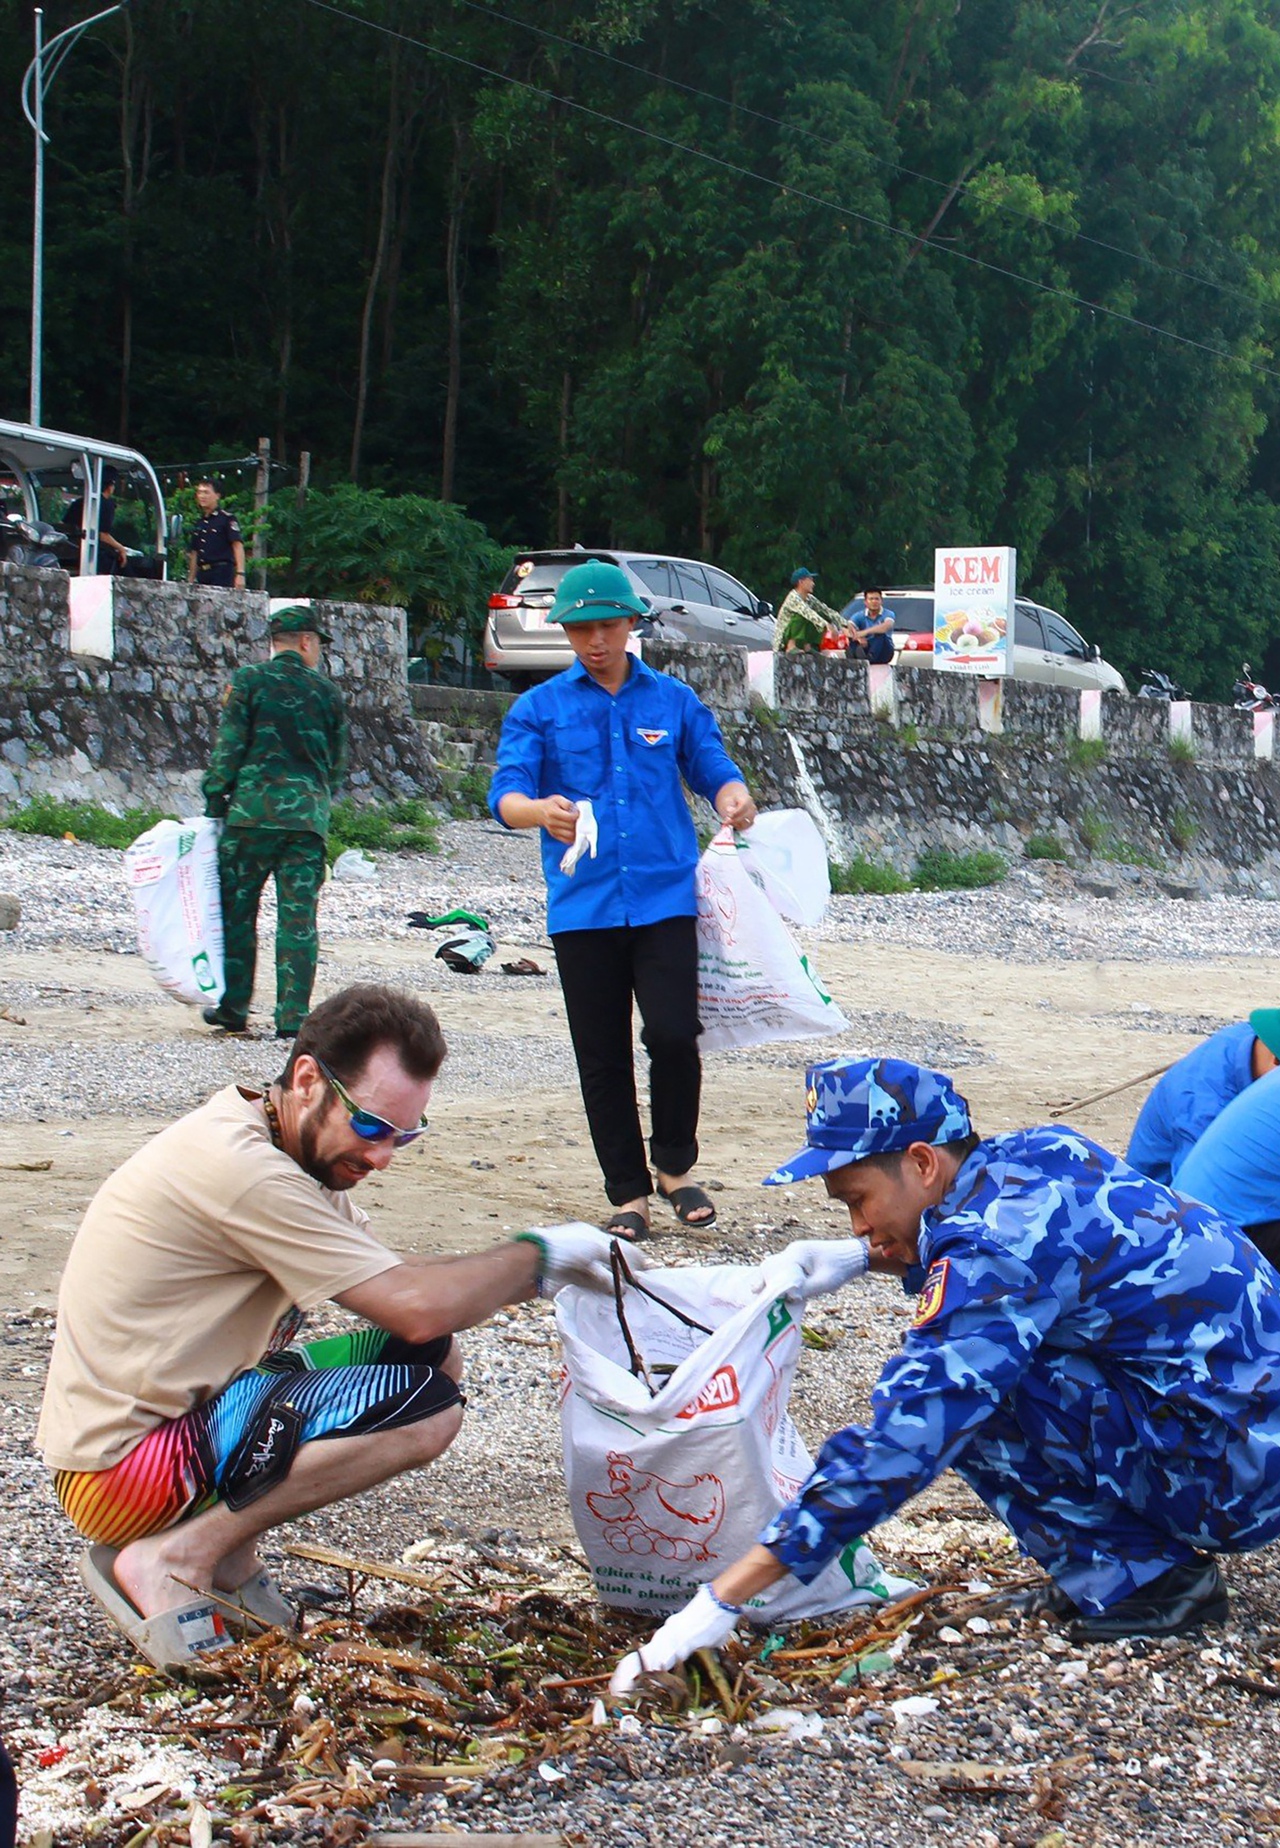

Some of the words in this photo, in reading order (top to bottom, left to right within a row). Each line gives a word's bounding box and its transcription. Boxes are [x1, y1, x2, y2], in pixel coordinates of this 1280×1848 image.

[943, 556, 1000, 584] KEM
[949, 587, 964, 596] ice
[966, 586, 995, 596] cream
